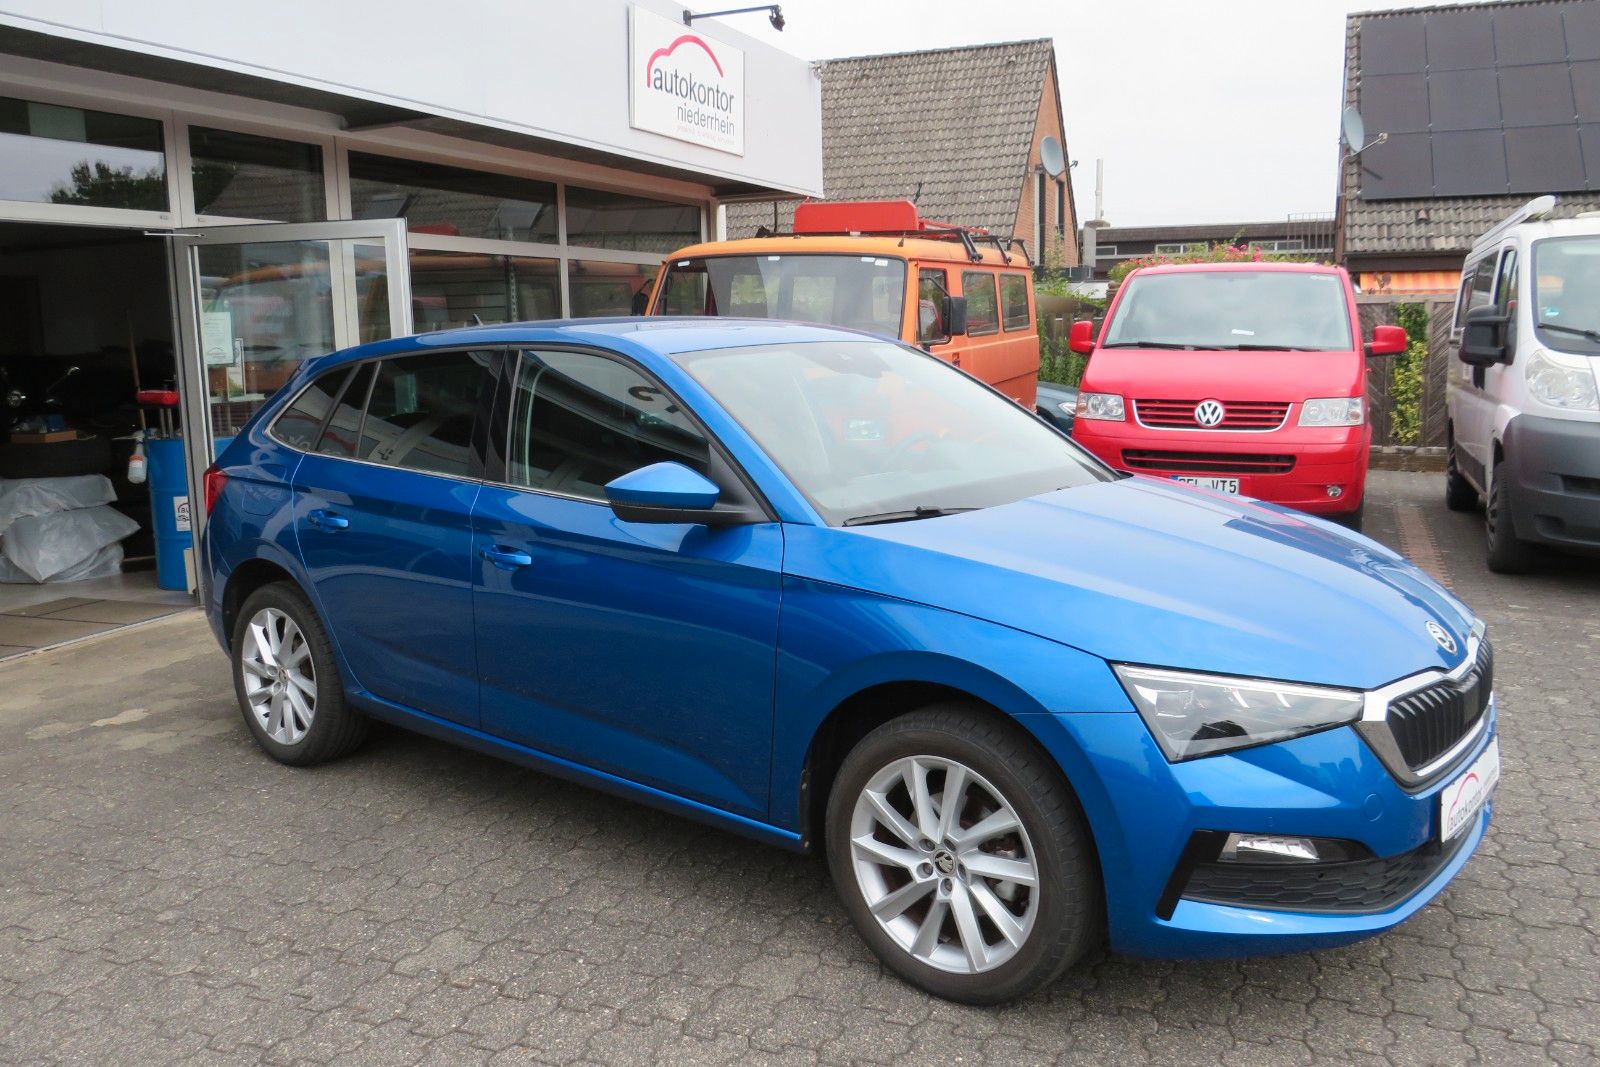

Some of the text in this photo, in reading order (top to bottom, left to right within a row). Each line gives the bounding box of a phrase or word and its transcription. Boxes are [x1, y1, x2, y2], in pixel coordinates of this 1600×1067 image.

[653, 68, 735, 114] autokontor
[677, 102, 735, 137] niederrhein
[1195, 400, 1224, 427] VW
